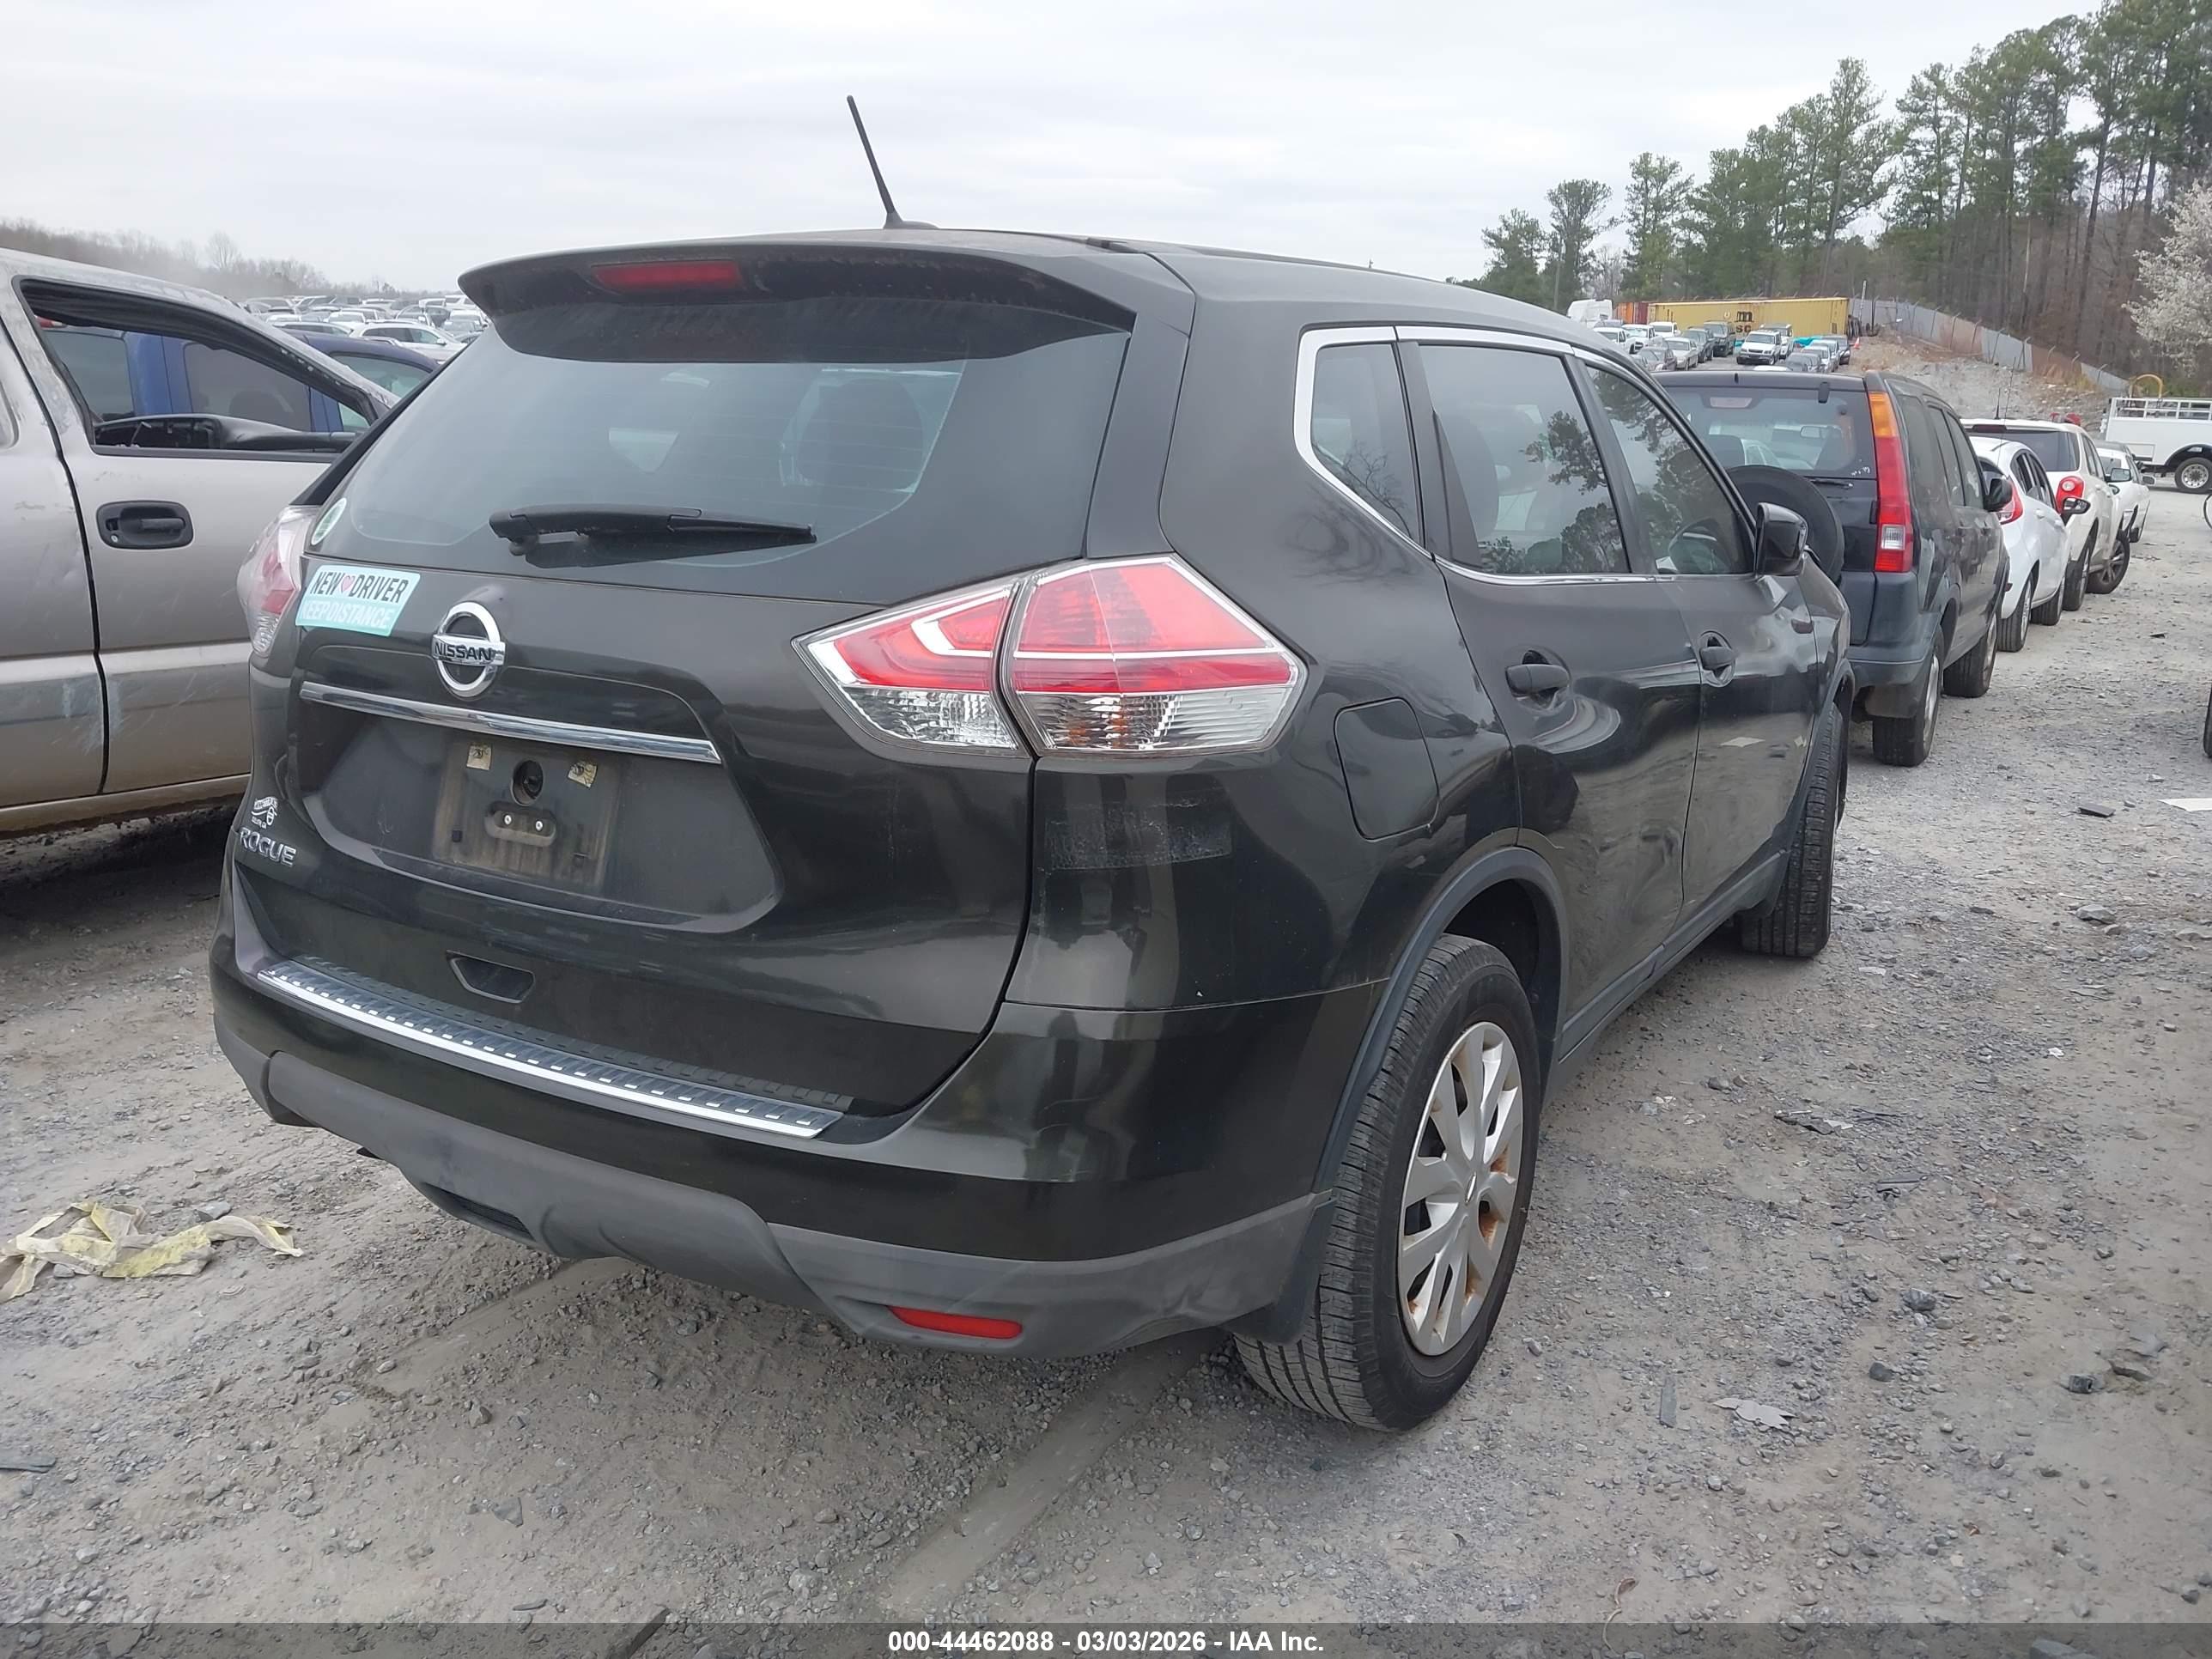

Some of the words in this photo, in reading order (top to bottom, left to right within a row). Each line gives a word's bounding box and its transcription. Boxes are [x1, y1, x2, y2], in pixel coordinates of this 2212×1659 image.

[310, 571, 345, 596] NEW
[348, 574, 409, 604] DRIVER
[434, 641, 492, 661] NISSAN
[240, 827, 297, 866] ROGUE
